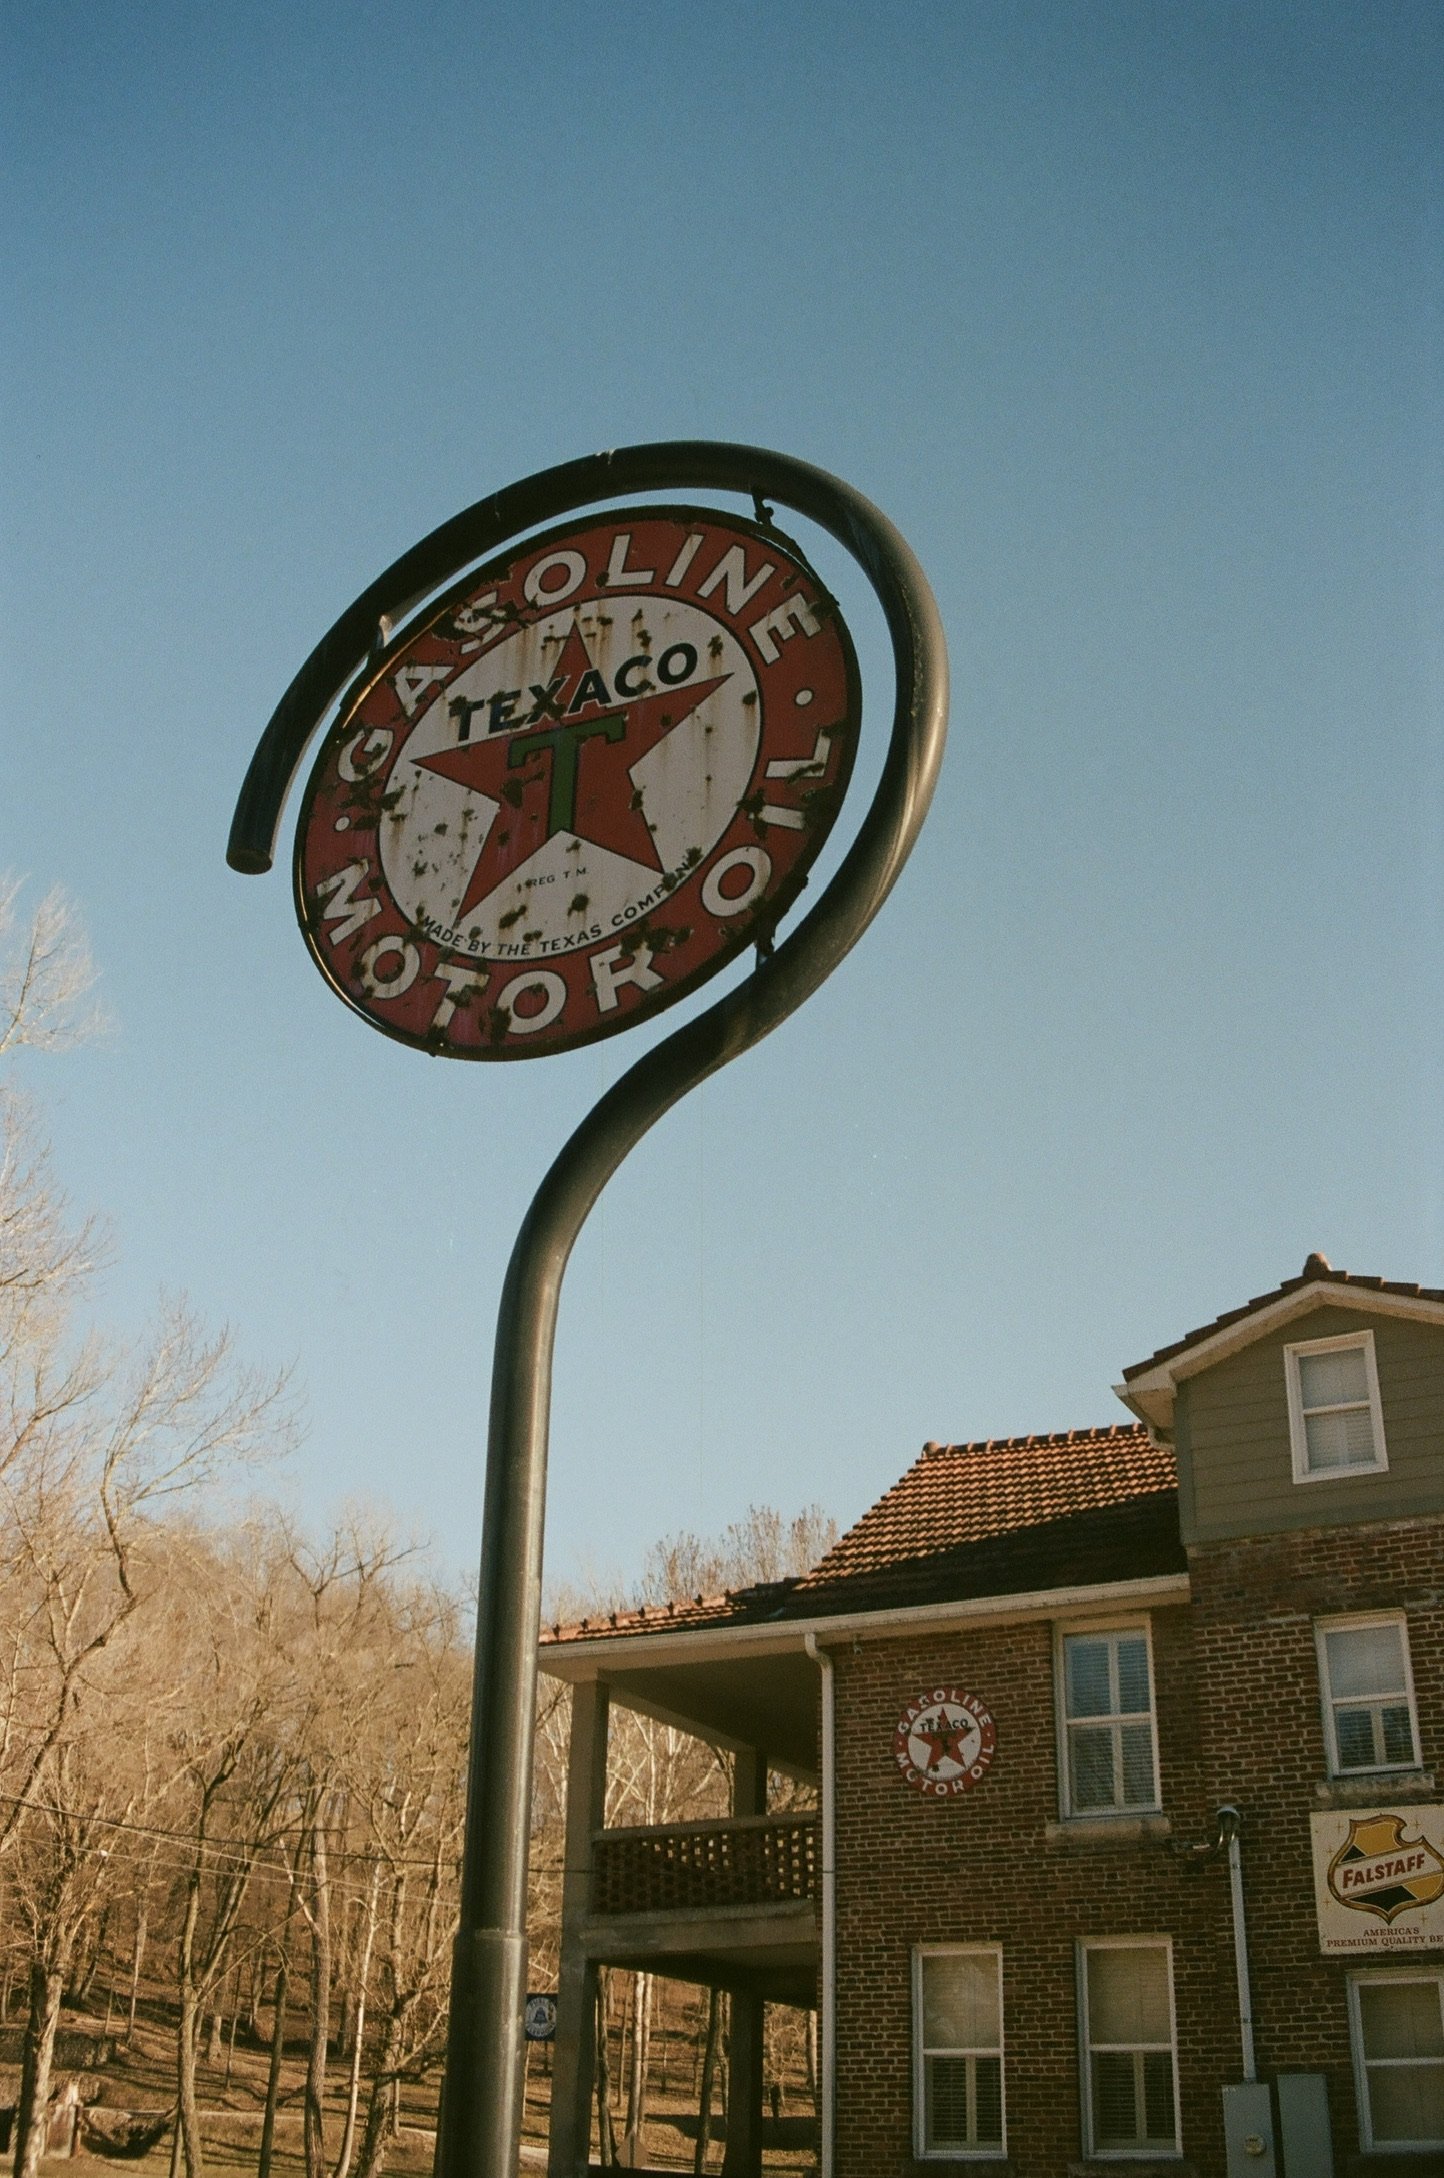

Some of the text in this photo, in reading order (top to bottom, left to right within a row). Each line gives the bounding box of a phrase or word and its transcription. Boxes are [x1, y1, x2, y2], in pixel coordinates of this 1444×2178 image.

[337, 534, 822, 783] GASOLINE
[449, 643, 698, 742] TEXACO
[508, 711, 629, 838] T
[316, 729, 831, 1034] MOTOR OIL
[423, 847, 700, 956] MADE BY THE TEXAS COMPN
[898, 1689, 992, 1733] GASOLINE
[920, 1718, 968, 1732] TEXACO
[896, 1744, 994, 1795] MOTOR OIL
[1342, 1853, 1425, 1889] FALSTAFF
[1327, 1938, 1377, 1947] PREMIUM
[1381, 1936, 1425, 1946] QUALITY
